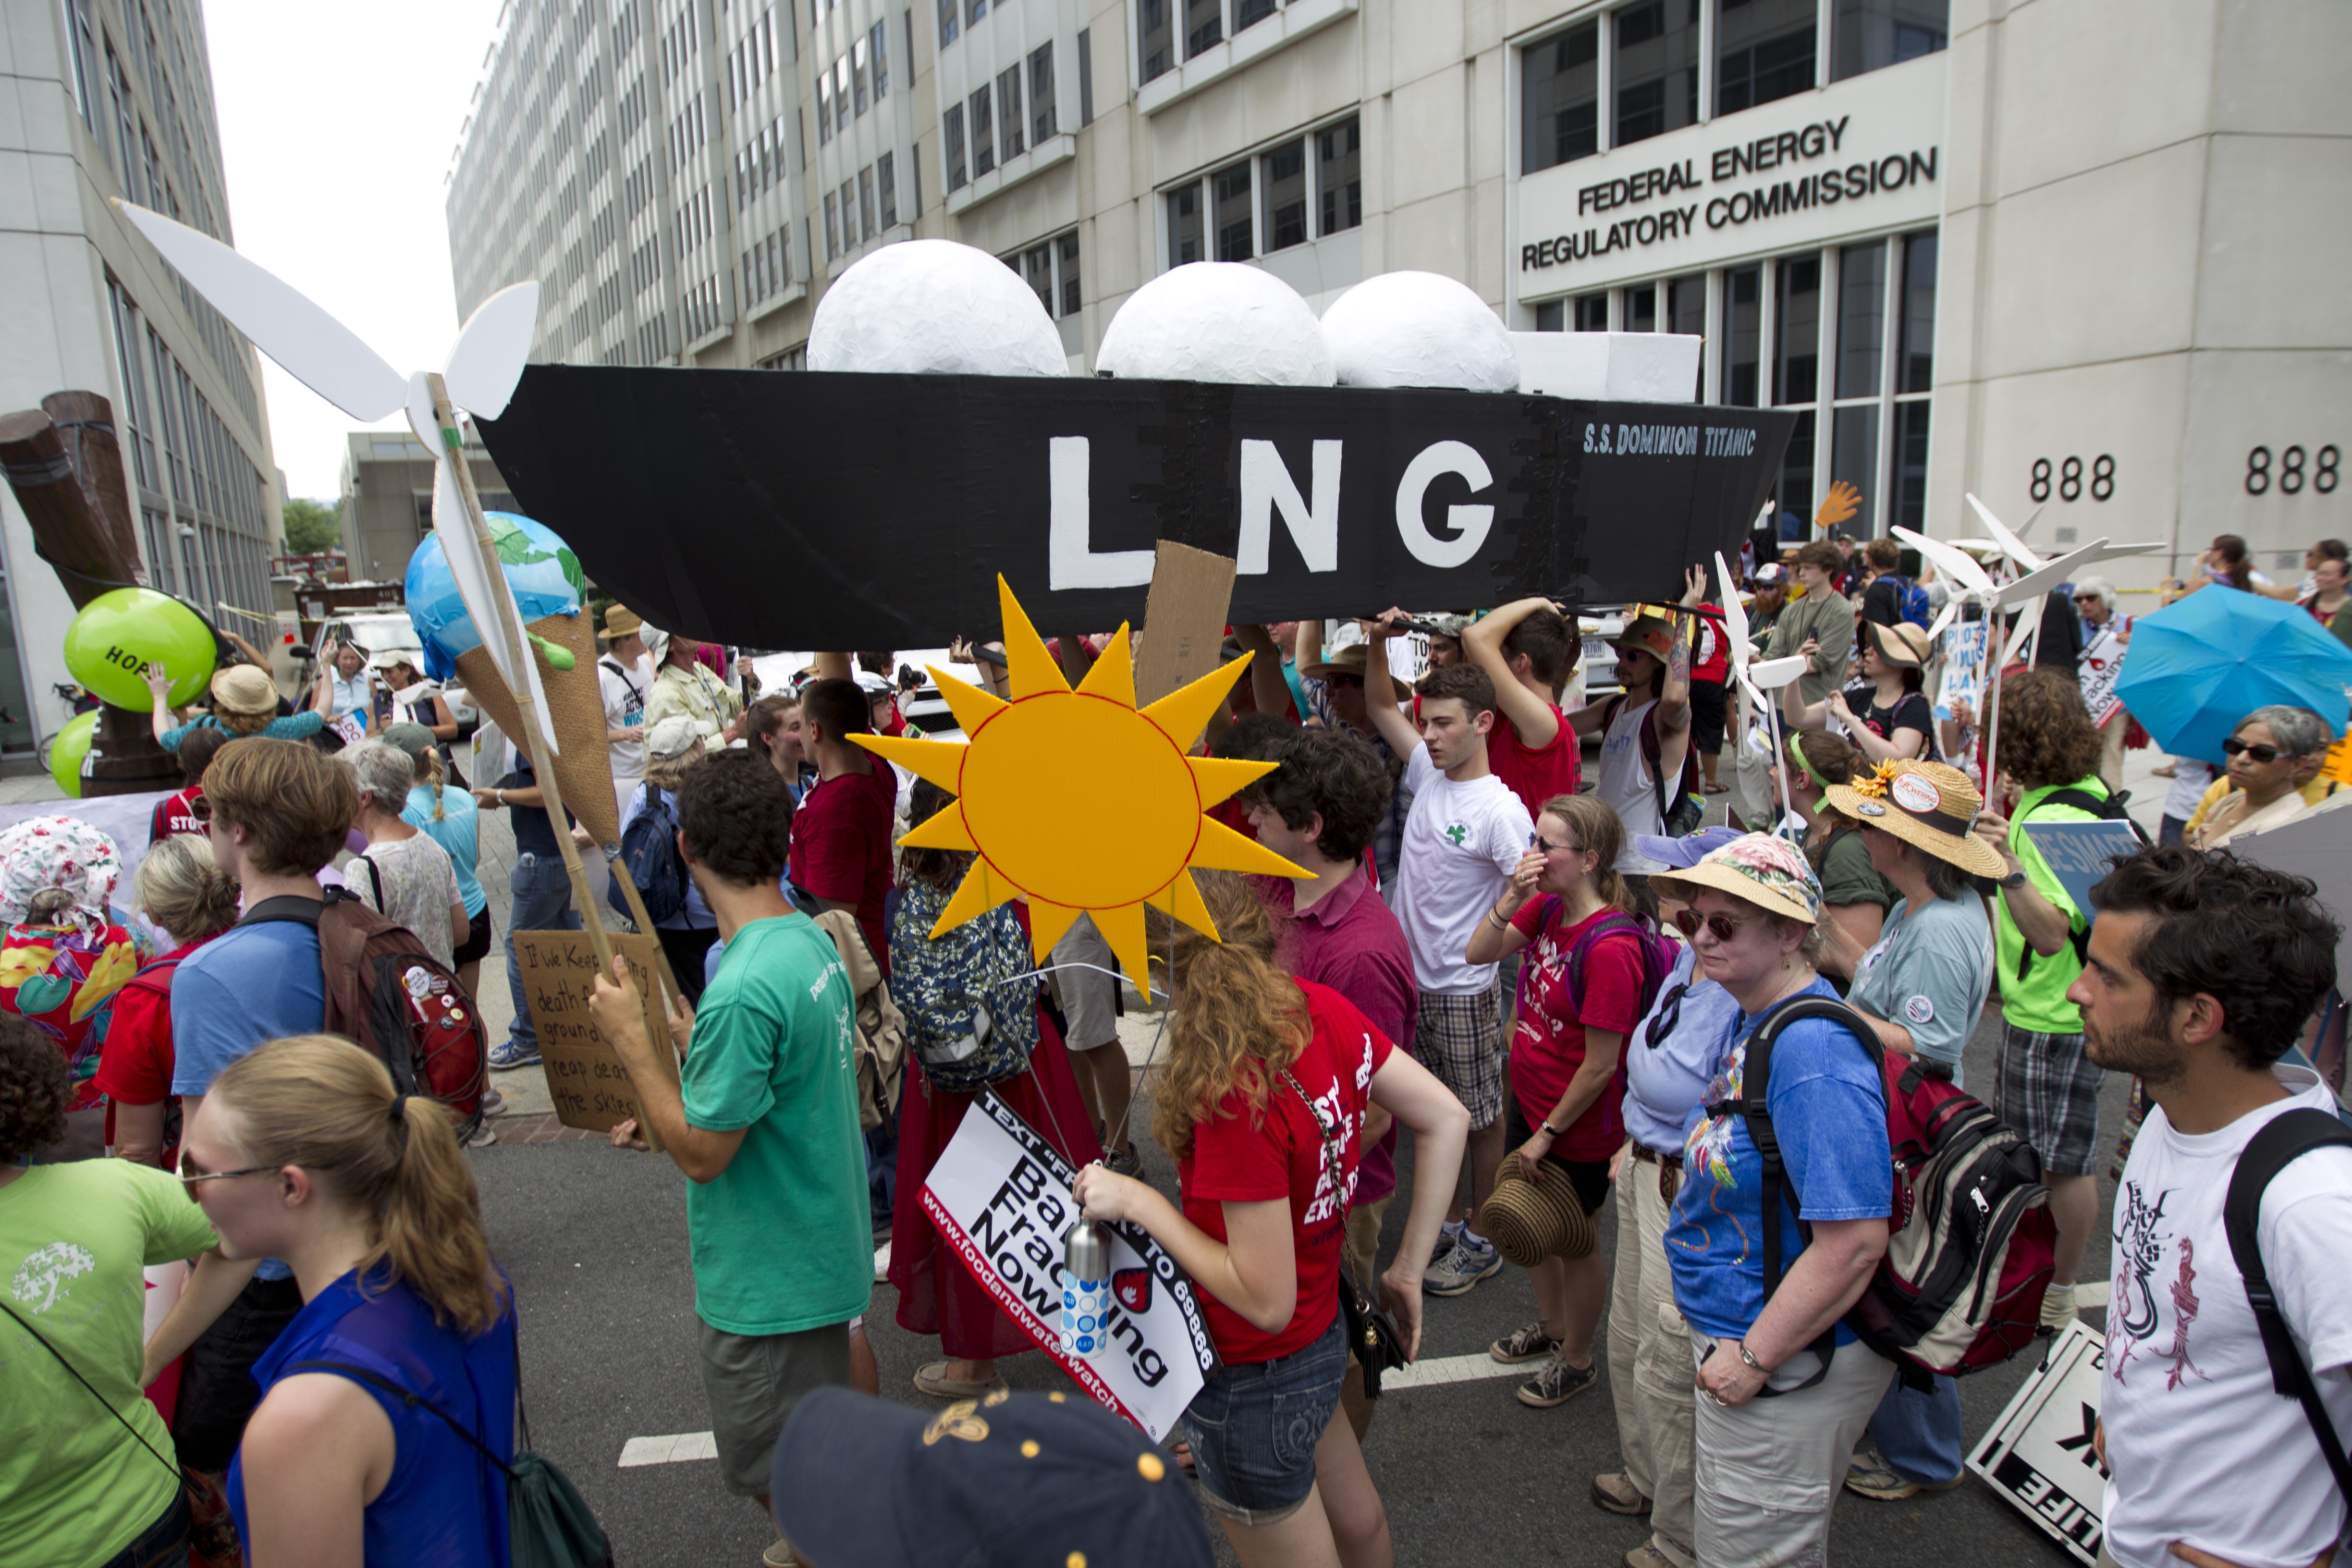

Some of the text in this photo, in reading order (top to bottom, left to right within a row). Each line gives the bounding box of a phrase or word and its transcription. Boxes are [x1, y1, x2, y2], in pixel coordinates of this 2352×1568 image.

[1579, 115, 1851, 217] FEDERAL ENERGY
[1522, 146, 1938, 271] REGULATORY COMMISSION
[1583, 423, 1756, 457] S.S. DOMINION TITANIC
[2030, 453, 2116, 503] 888
[2244, 443, 2341, 496] 888
[1050, 435, 1494, 591] LNG
[105, 645, 151, 680] HOP
[171, 816, 206, 831] STO
[538, 979, 579, 1013] death
[544, 1021, 599, 1045] ground
[551, 1058, 588, 1087] reap
[557, 1088, 585, 1115] the
[1008, 1154, 1076, 1246] Ba
[984, 1090, 1041, 1155] TEXT
[1144, 1237, 1175, 1280] TO
[1174, 1279, 1214, 1372] 69866
[969, 1208, 1063, 1318] Now
